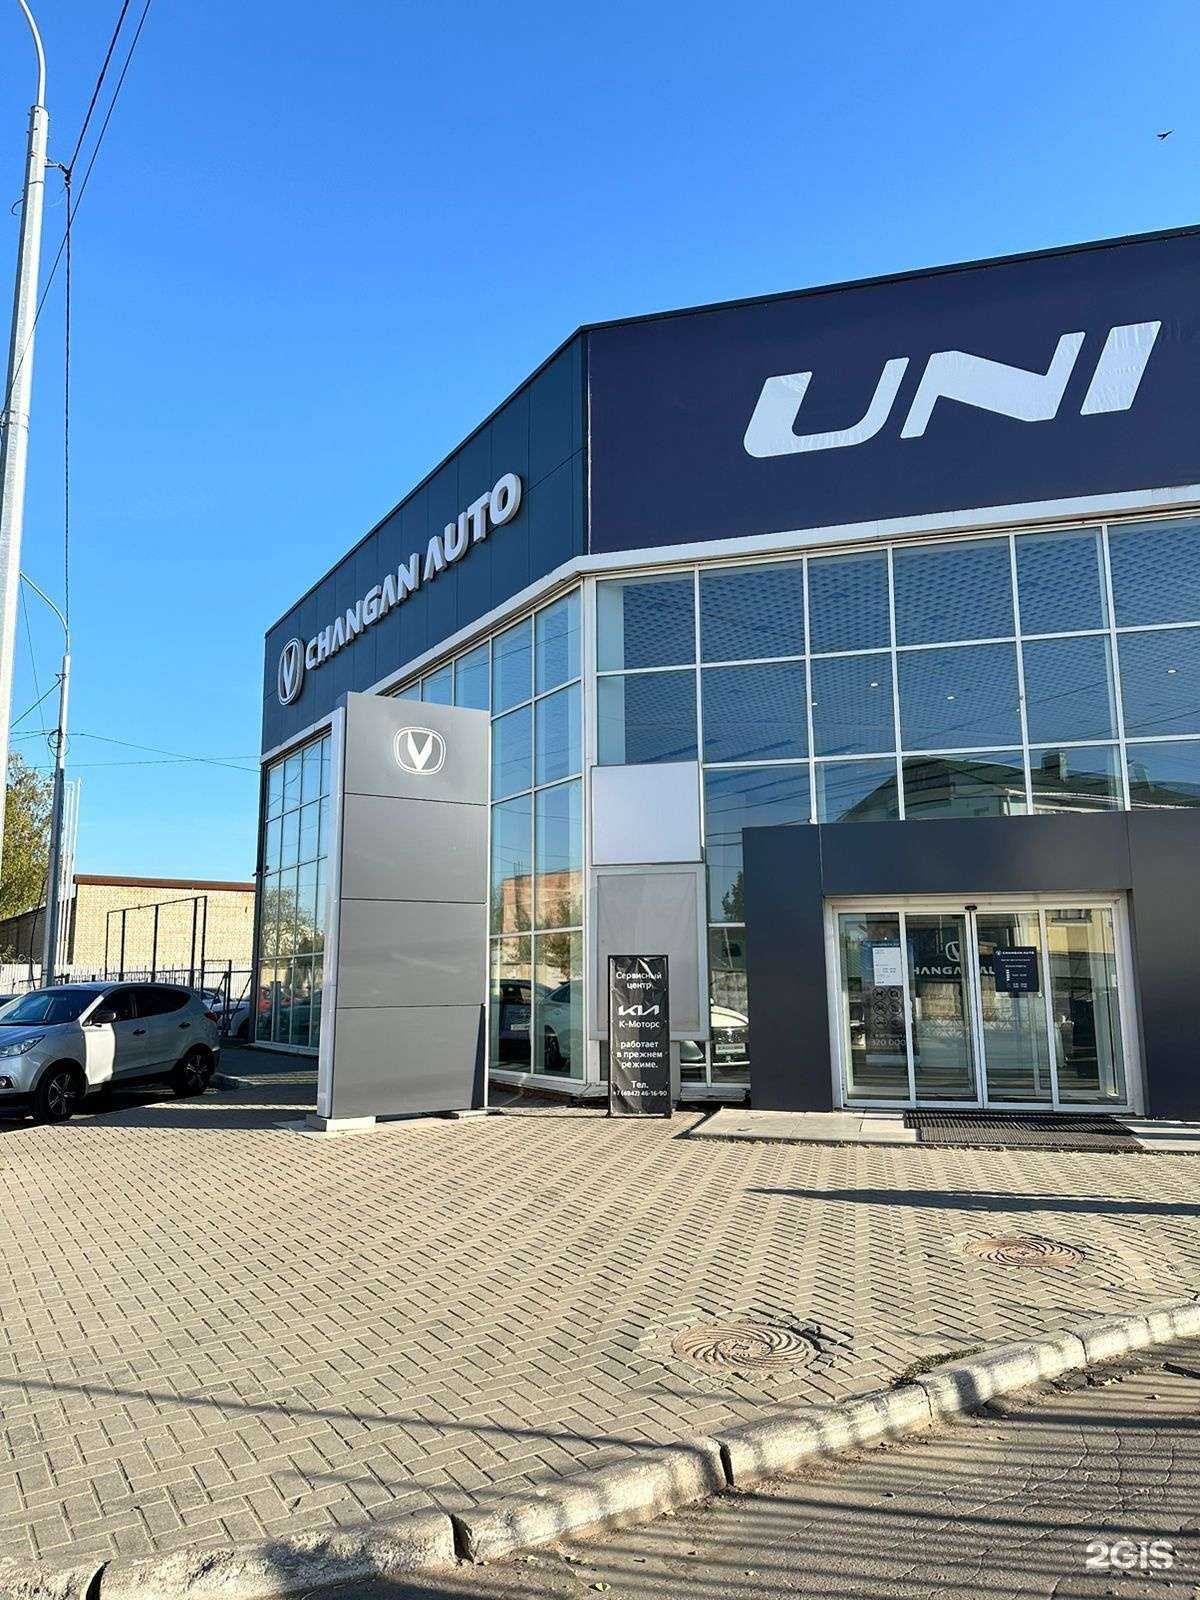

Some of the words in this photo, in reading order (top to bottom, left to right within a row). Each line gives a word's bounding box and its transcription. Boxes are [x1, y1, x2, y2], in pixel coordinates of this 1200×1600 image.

[743, 319, 1162, 458] UNI
[305, 552, 419, 671] CHANGAN
[423, 472, 522, 582] AUTO
[913, 966, 962, 976] HANGA
[618, 1005, 660, 1016] KIA
[619, 1020, 660, 1028] К-Моторс
[620, 1040, 659, 1049] работает
[623, 1051, 663, 1059] прежнем
[621, 1061, 658, 1069] режиме.
[630, 1080, 649, 1089] Тел.
